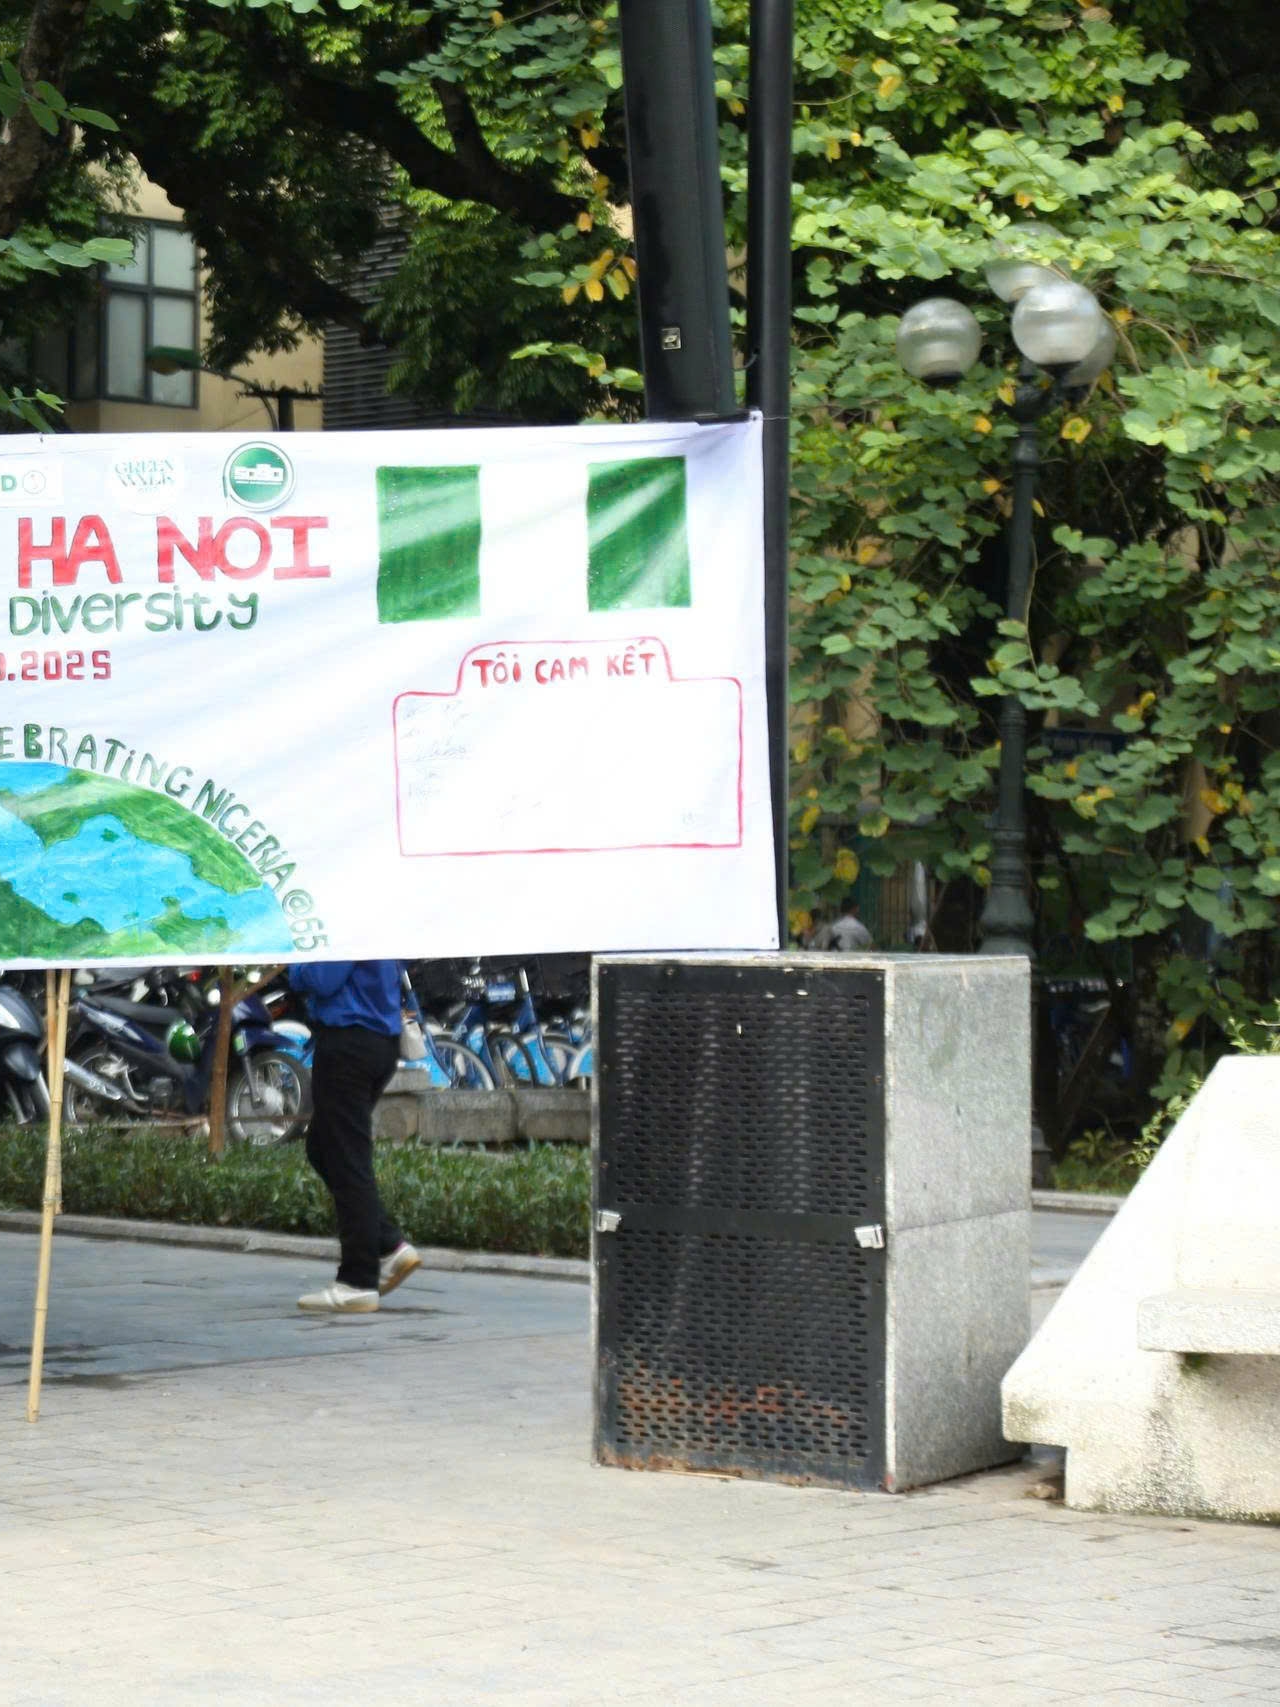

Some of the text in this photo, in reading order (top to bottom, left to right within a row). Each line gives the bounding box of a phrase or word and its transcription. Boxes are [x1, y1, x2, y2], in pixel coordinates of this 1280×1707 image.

[17, 514, 123, 588] HA
[156, 515, 332, 583] NOI
[8, 585, 259, 637] Diversity
[534, 655, 590, 685] CAM
[606, 640, 657, 678] KẾT
